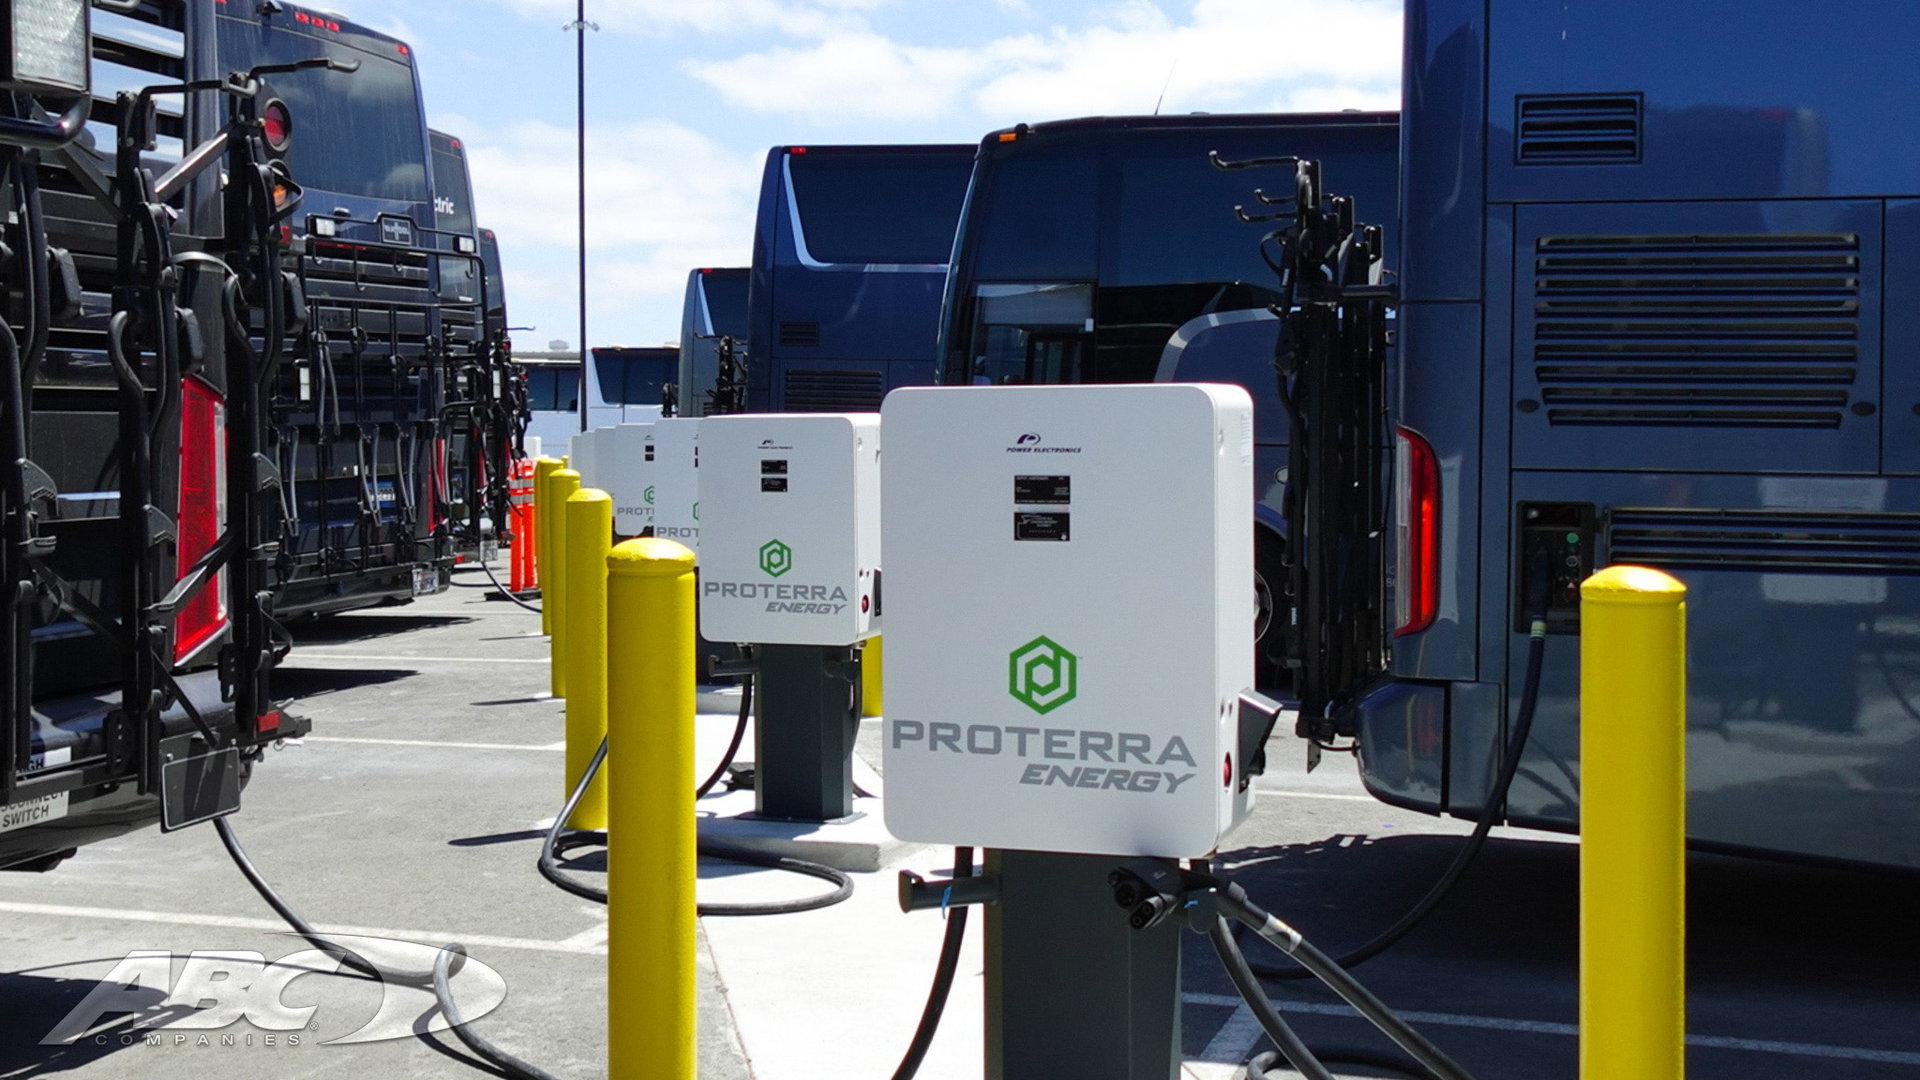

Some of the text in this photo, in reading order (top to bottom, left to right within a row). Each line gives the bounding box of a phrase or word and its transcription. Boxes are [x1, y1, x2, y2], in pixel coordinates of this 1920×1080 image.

[704, 581, 848, 602] PROTERRA
[765, 601, 847, 615] ENERGY
[892, 719, 1198, 768] PROTERRA
[1018, 763, 1198, 795] ENERGY
[2, 805, 49, 827] SWITCH
